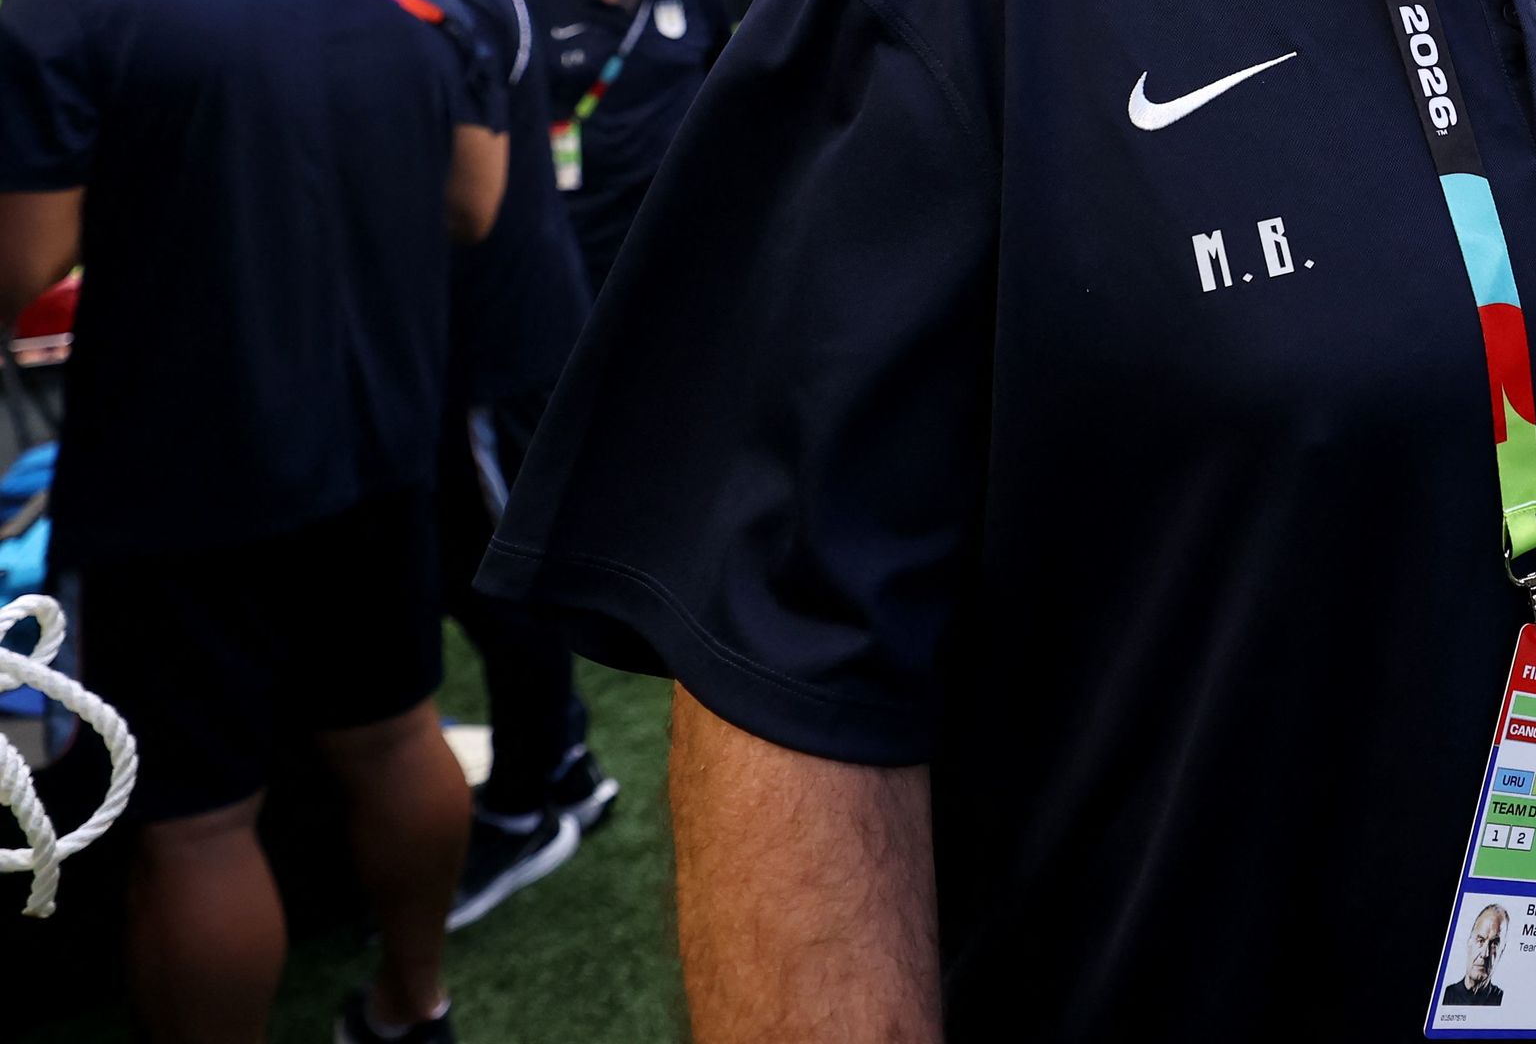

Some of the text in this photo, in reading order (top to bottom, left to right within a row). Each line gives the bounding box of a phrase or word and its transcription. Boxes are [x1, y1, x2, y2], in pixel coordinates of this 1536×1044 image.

[1399, 4, 1458, 129] 2026
[1502, 775, 1525, 788] URU
[1492, 801, 1527, 817] TEAM
[1492, 829, 1499, 842] 1
[1517, 832, 1526, 844] 2
